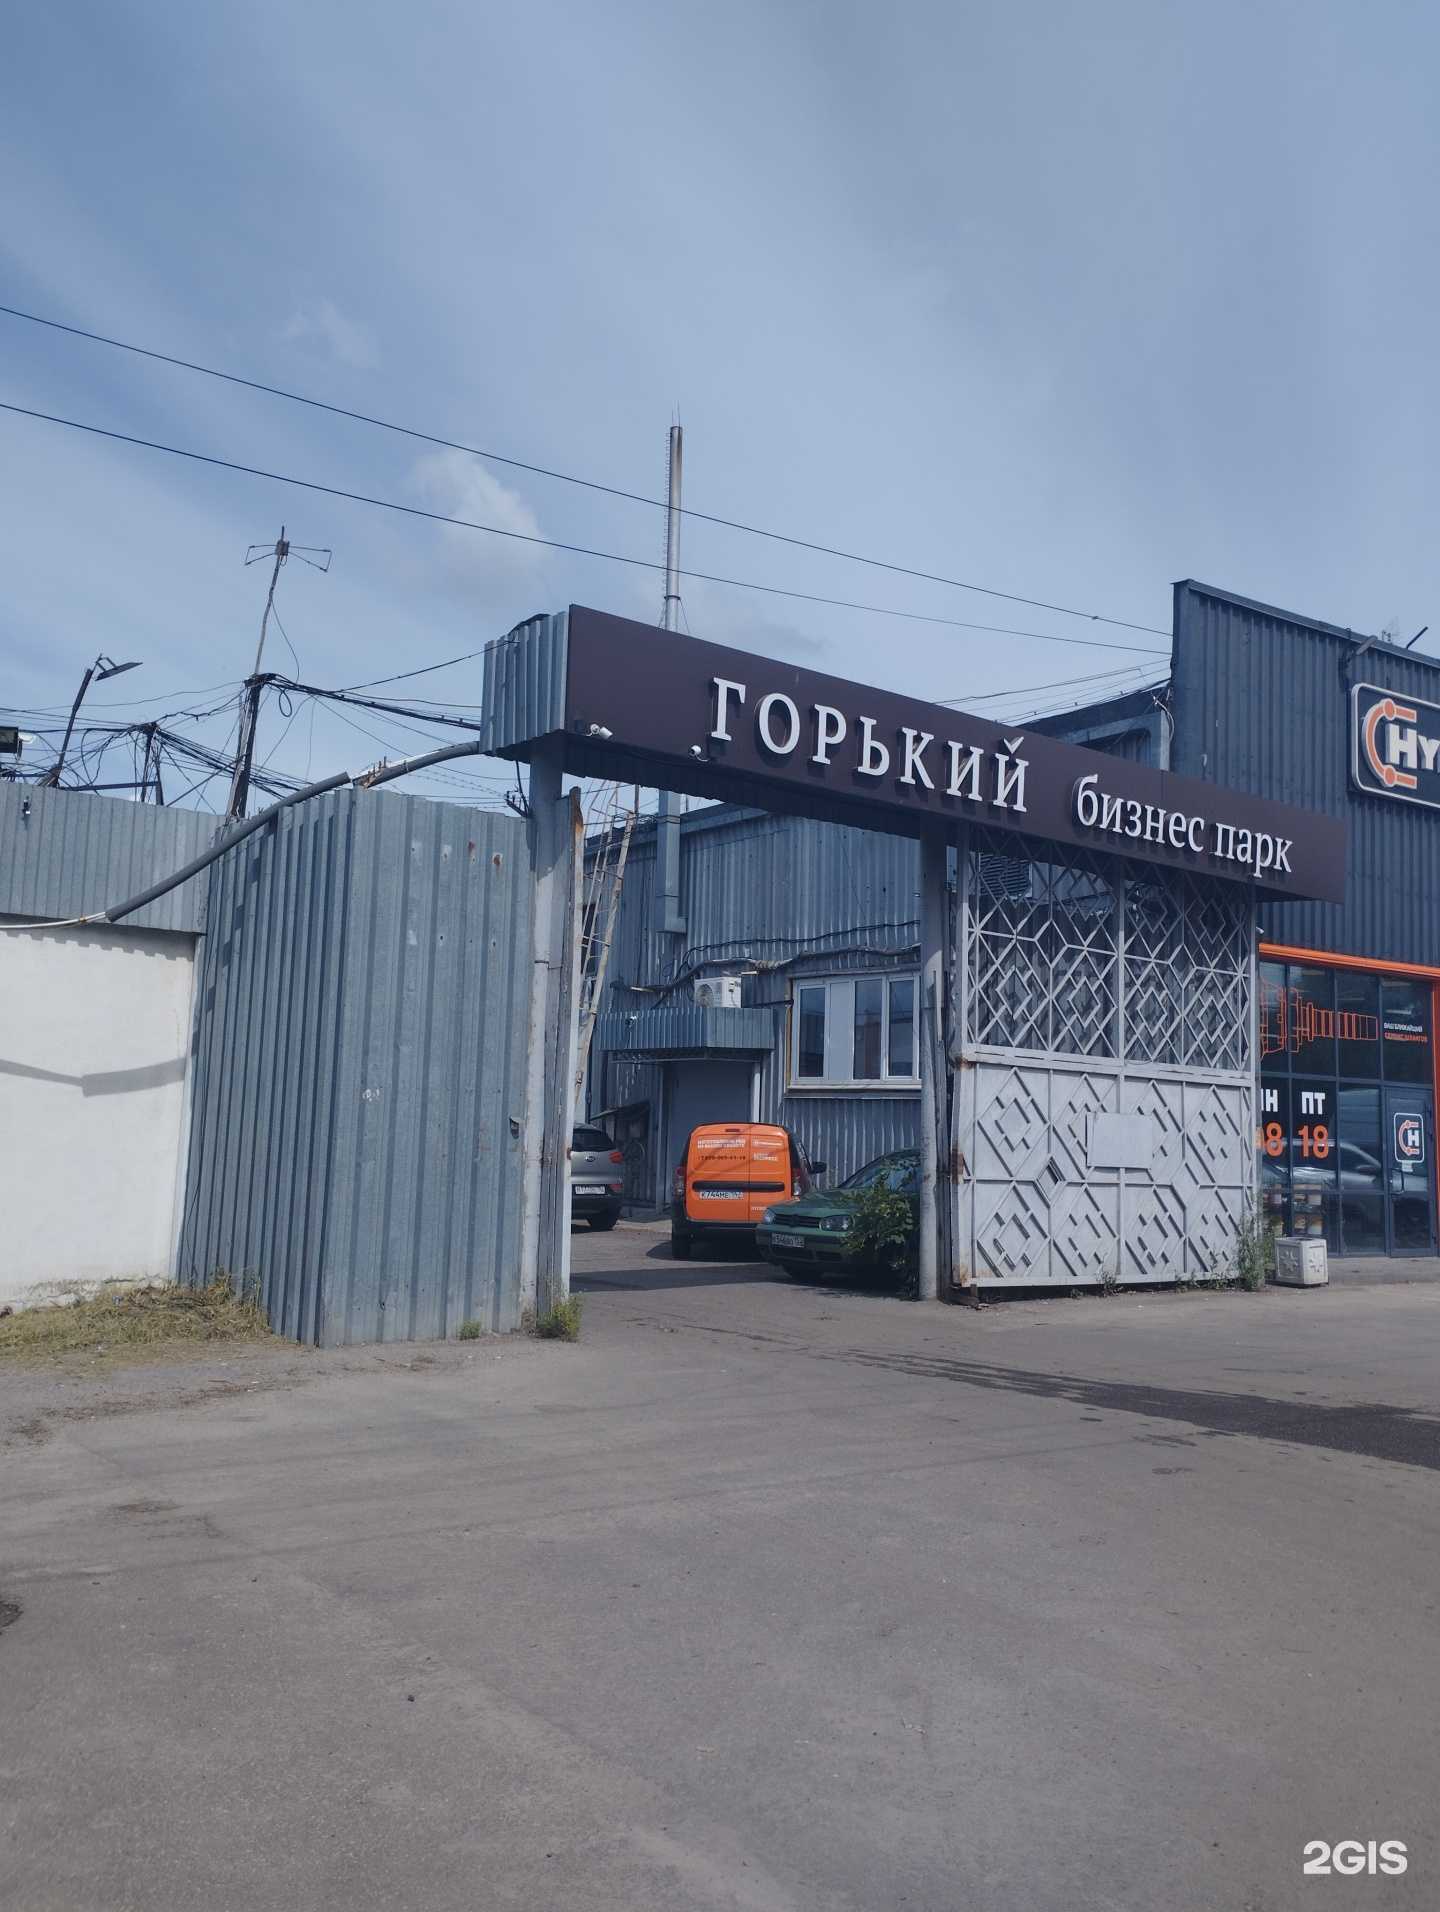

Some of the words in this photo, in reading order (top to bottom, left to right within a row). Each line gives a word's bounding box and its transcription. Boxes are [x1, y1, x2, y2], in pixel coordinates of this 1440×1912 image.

[711, 677, 1029, 812] ГОРЬКИЙ
[1075, 773, 1205, 853] бизнес
[1213, 821, 1294, 879] парк
[1301, 1091, 1327, 1115] ПТ
[1298, 1124, 1329, 1159] 18
